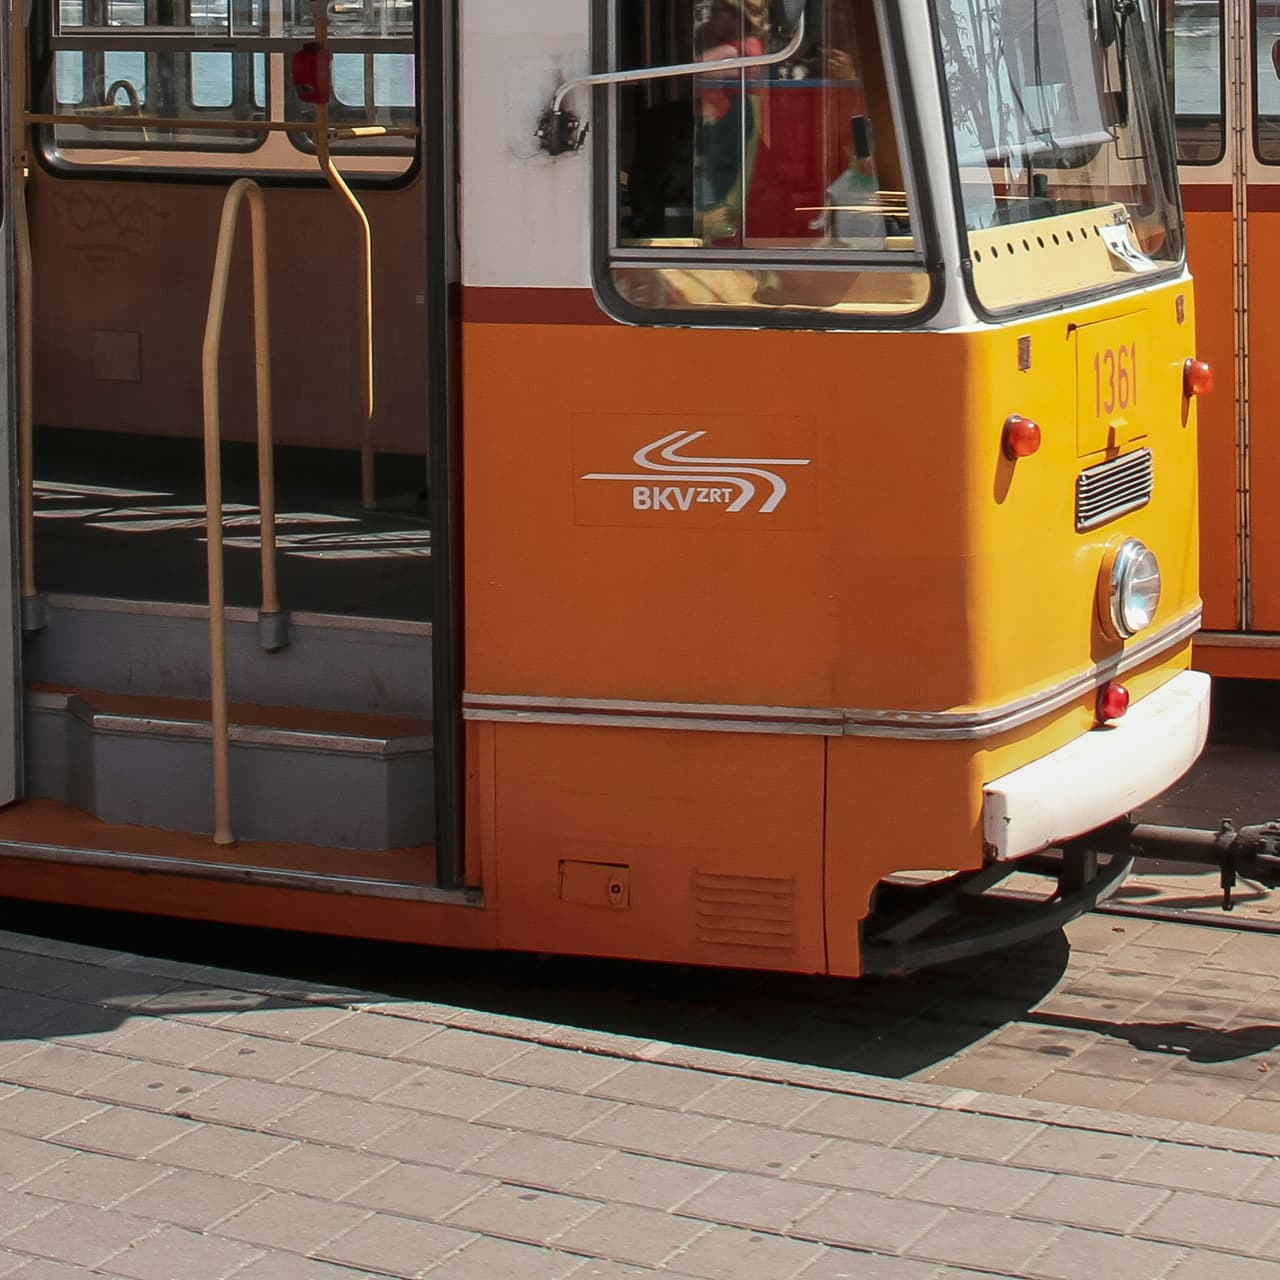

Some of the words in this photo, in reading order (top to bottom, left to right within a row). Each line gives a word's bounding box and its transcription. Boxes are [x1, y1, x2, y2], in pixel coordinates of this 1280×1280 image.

[1093, 341, 1137, 418] 1361
[632, 486, 696, 511] BKV
[696, 487, 733, 503] ZRT
